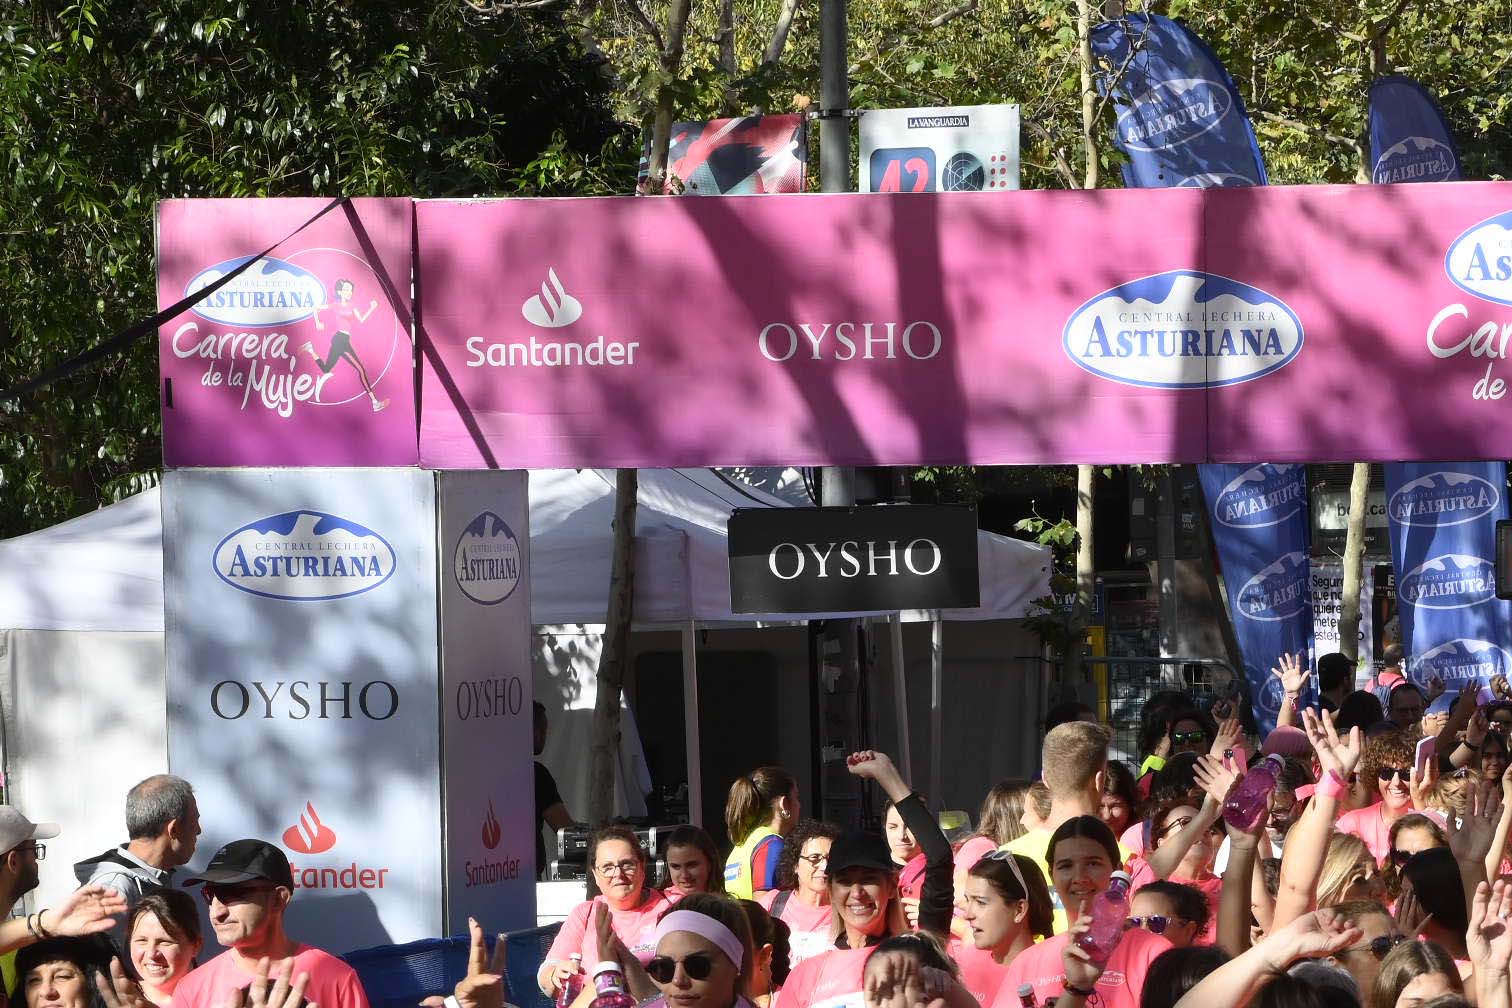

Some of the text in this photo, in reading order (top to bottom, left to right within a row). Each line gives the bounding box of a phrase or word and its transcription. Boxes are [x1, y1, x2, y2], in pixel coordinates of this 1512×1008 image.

[197, 282, 315, 308] ASTURIANA
[1118, 310, 1278, 323] CENTRAL LECHERA
[172, 322, 289, 359] Carrera
[466, 335, 639, 368] Santander
[759, 321, 942, 361] OYSHO
[1083, 316, 1284, 358] ASTURIANA
[201, 356, 335, 417] de la Mujer
[1472, 362, 1507, 400] de
[228, 544, 383, 577] ASTURIANA
[255, 541, 377, 551] CENTRAL LECHERA
[460, 545, 518, 582] ASTURIANA
[768, 539, 942, 580] OYSHO
[1313, 591, 1329, 603] que
[1313, 603, 1342, 616] quiere
[211, 680, 399, 720] OYSHO
[456, 676, 523, 721] OYSHO
[291, 862, 389, 889] tander
[465, 854, 520, 889] Santander
